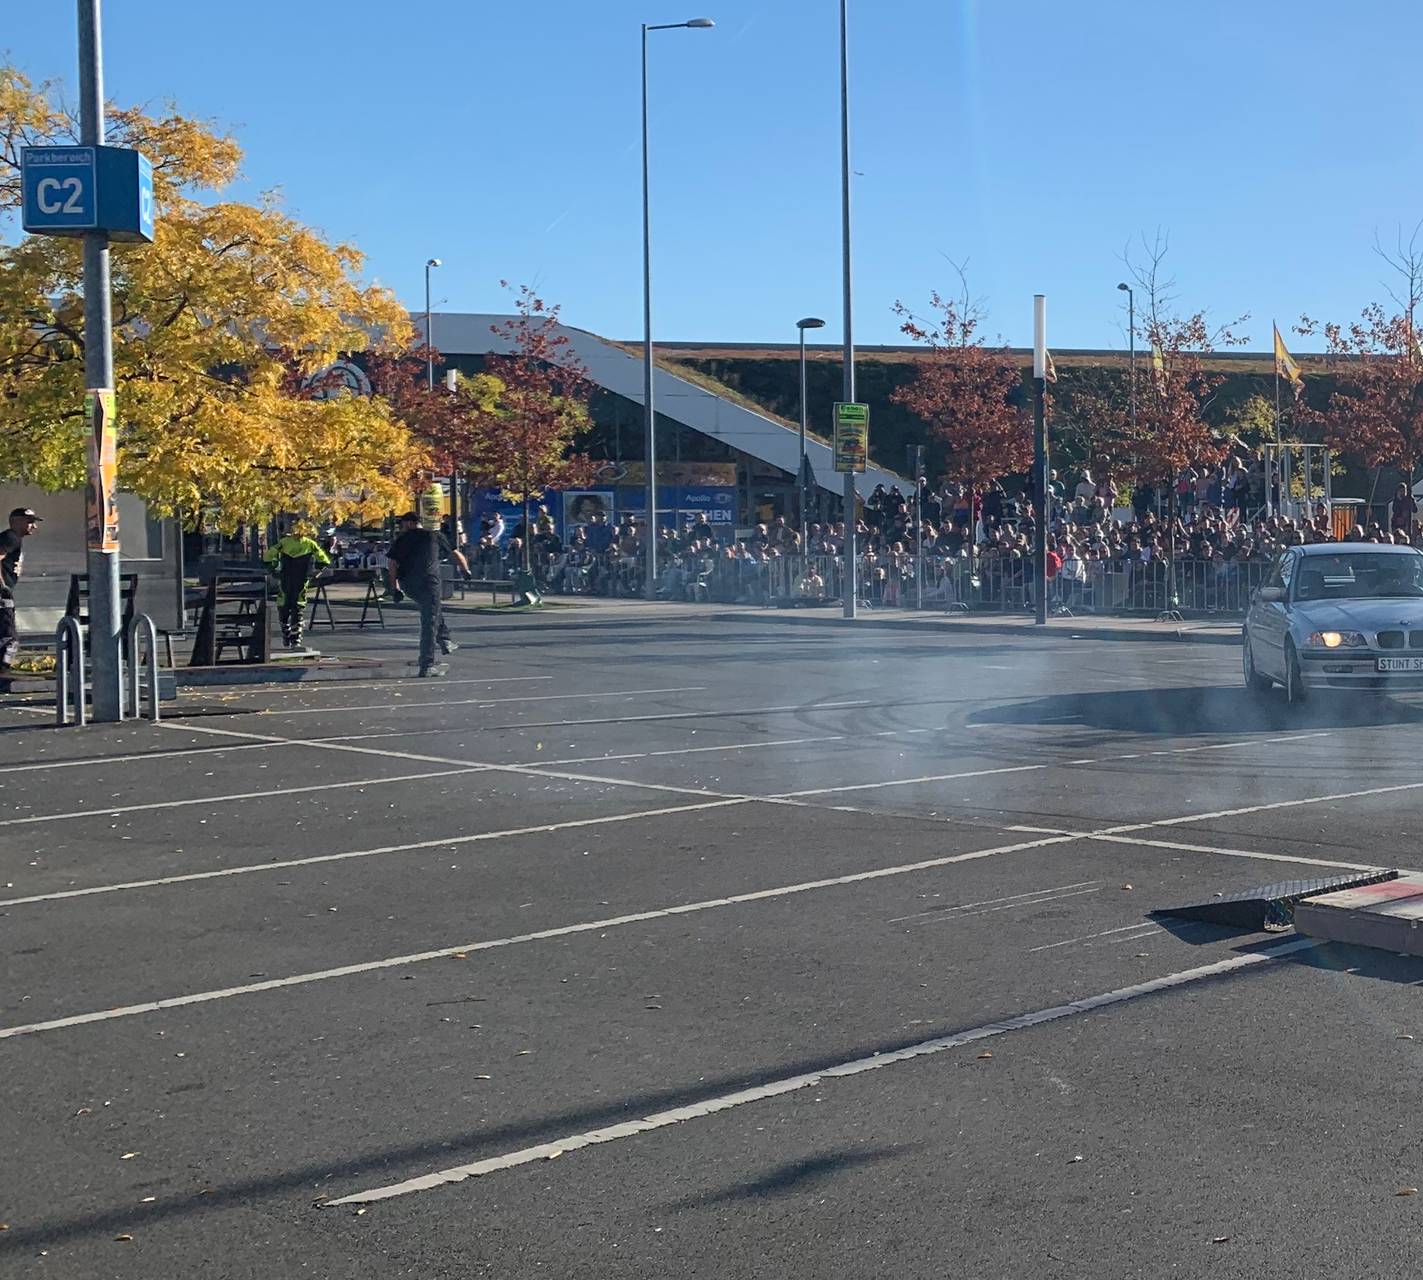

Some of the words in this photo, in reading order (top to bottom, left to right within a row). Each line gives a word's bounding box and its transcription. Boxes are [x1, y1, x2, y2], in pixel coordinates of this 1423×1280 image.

[26, 152, 91, 163] Parkbereich
[37, 177, 83, 214] C2
[685, 510, 732, 521] SHEN
[1380, 659, 1409, 669] STUNT
